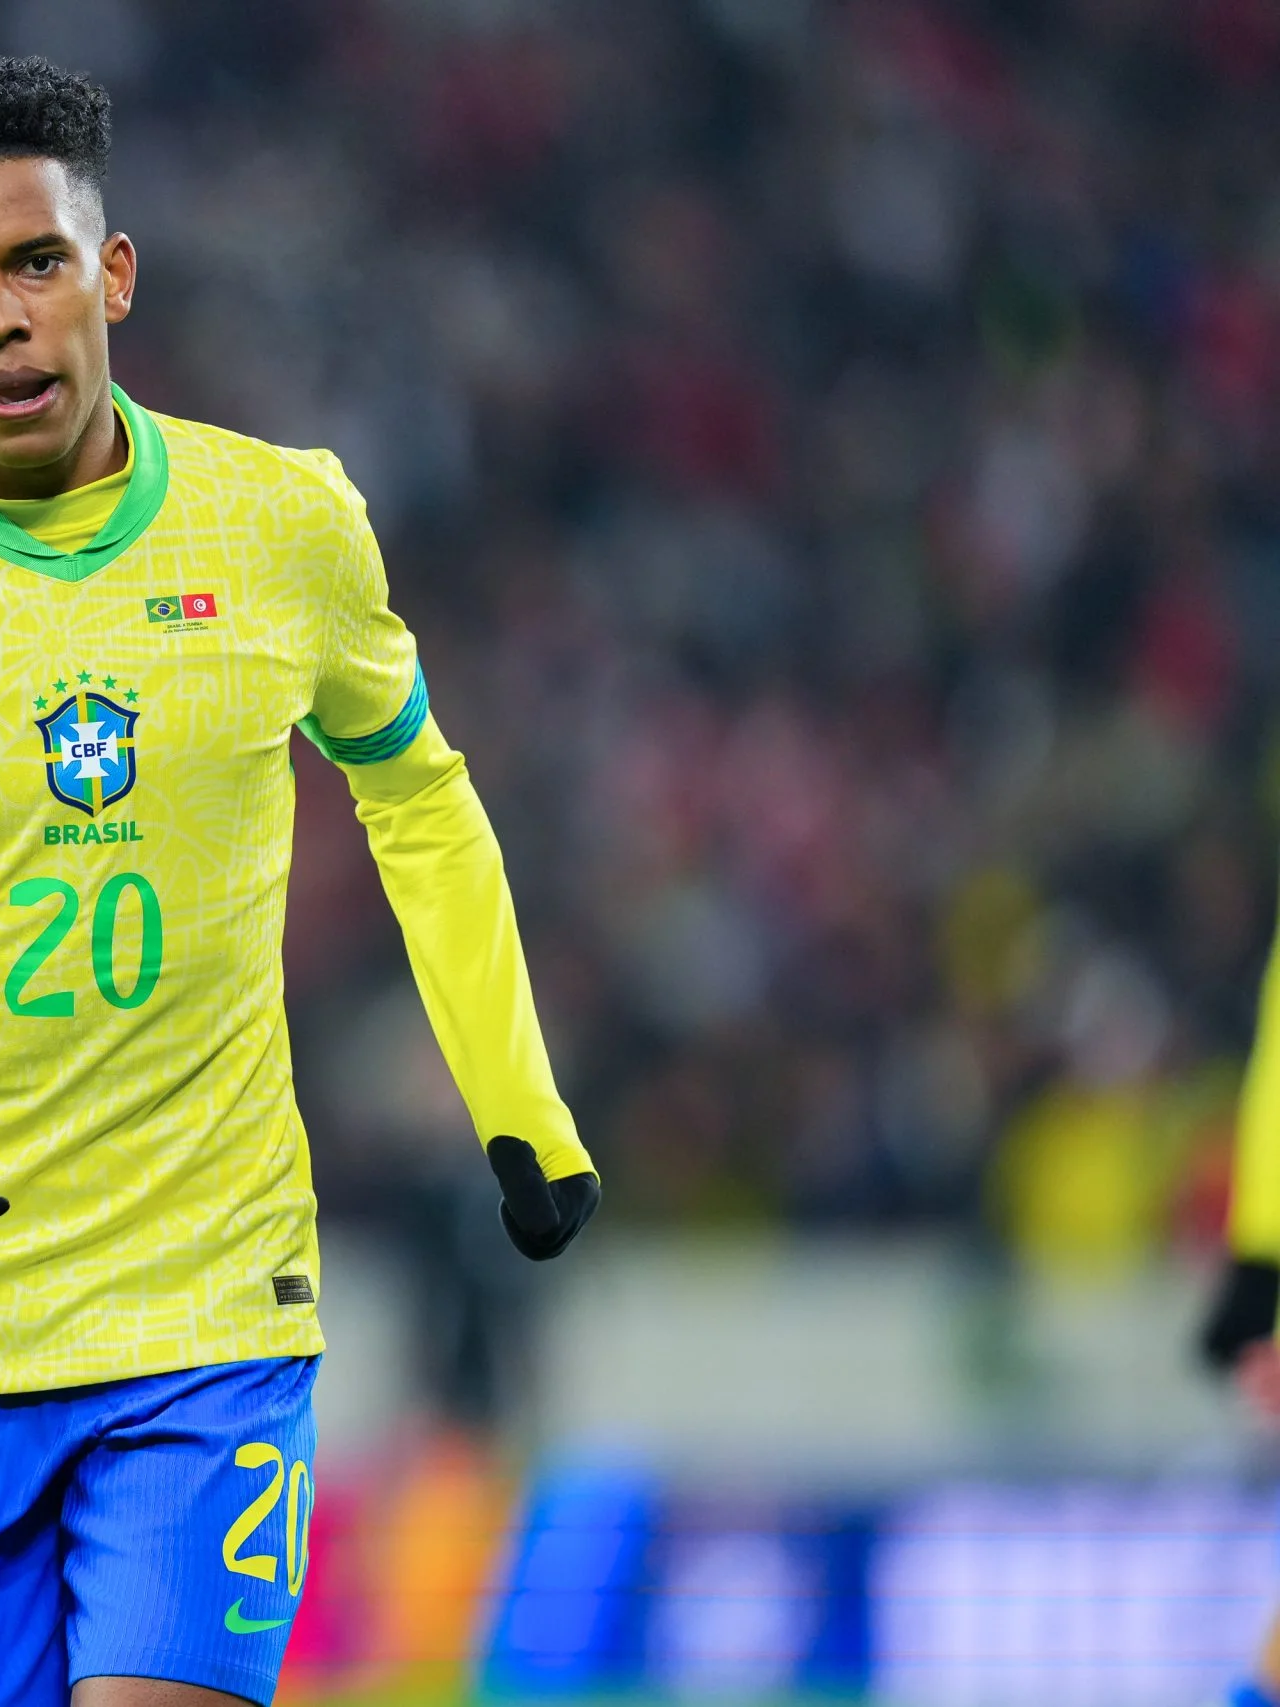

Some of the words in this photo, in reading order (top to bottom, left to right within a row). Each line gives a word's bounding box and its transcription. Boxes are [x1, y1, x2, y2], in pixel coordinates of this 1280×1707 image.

[71, 742, 107, 758] CBF
[44, 821, 144, 846] BRASIL
[4, 872, 163, 1018] 20
[222, 1441, 310, 1597] 20
